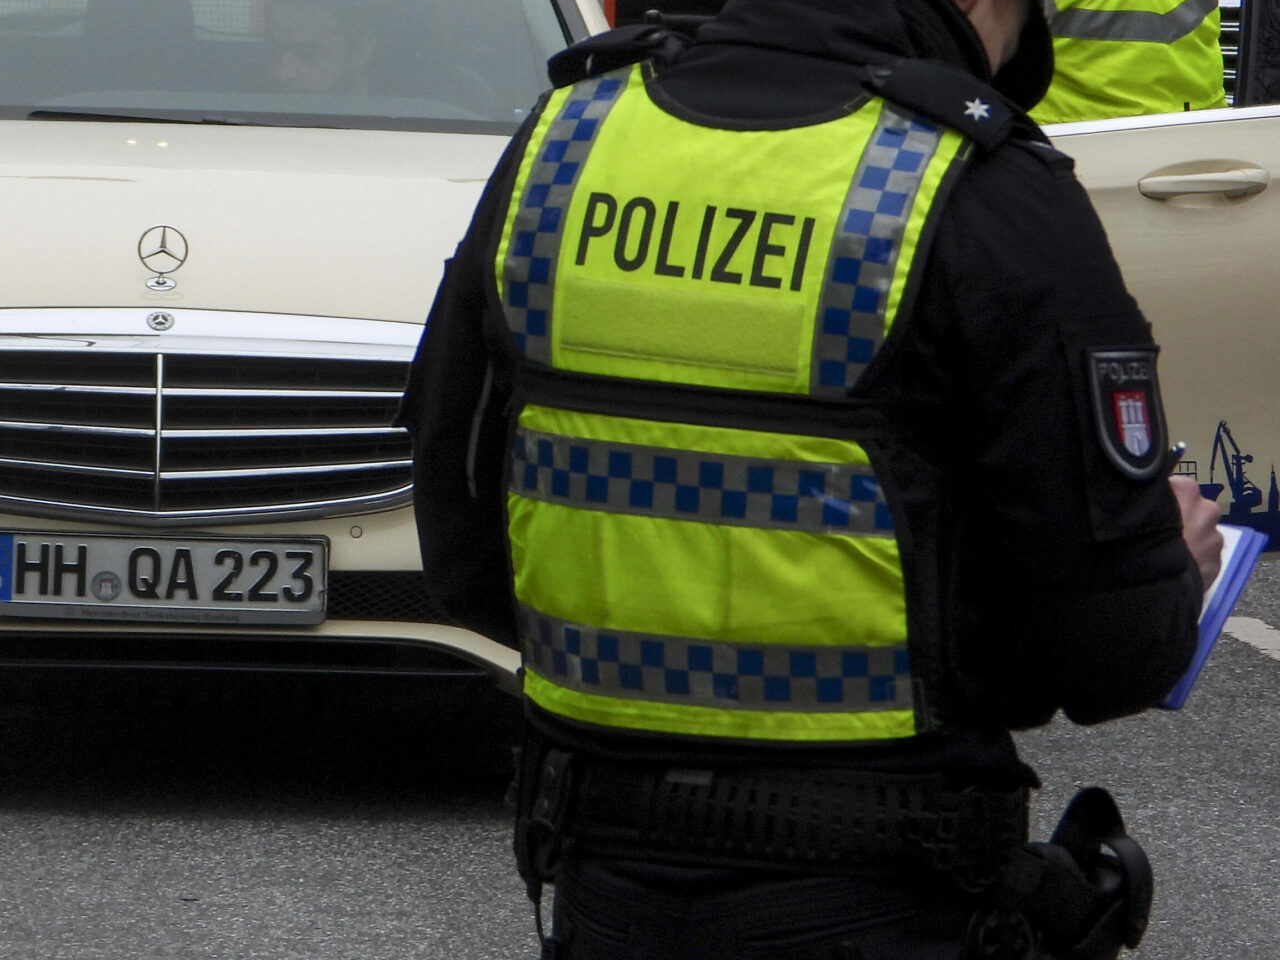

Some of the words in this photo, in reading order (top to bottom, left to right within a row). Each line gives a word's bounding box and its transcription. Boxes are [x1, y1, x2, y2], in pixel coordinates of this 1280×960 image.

[575, 192, 816, 292] POLIZEI
[15, 541, 88, 597] HH
[127, 546, 199, 600] QA
[212, 550, 315, 603] 223
